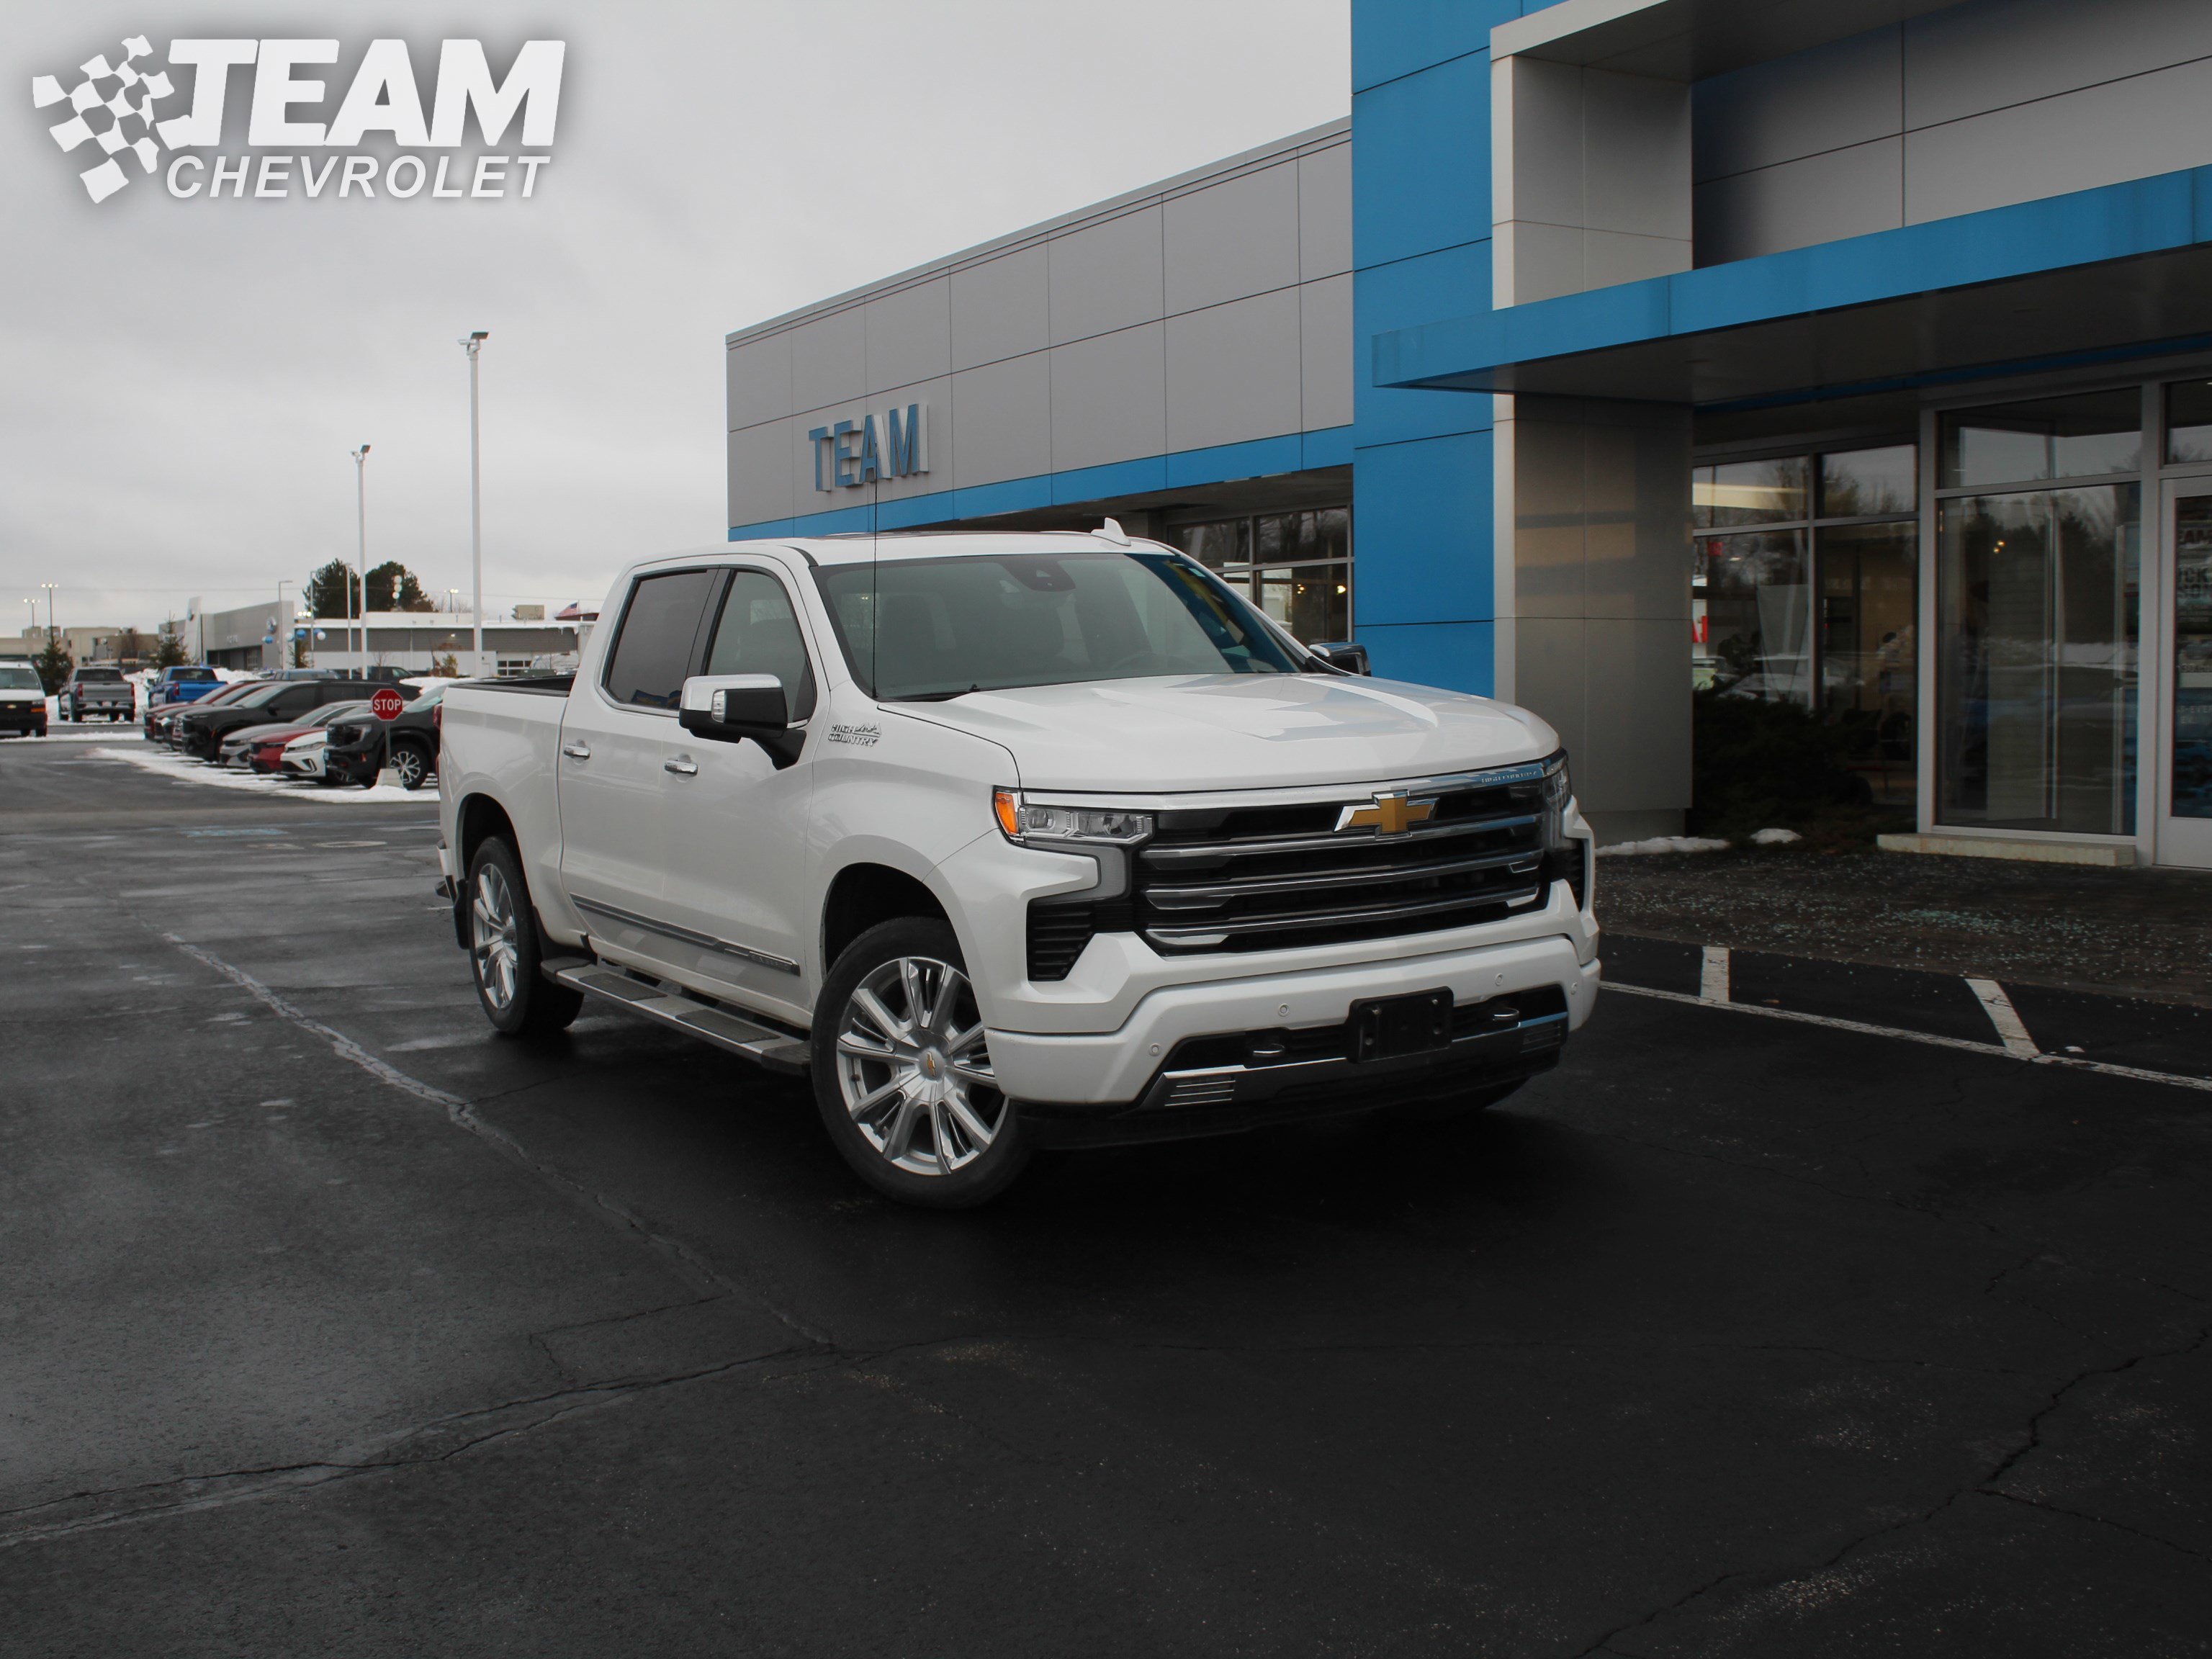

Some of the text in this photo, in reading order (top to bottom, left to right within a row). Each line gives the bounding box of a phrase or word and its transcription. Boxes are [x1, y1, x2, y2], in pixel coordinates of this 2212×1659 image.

[808, 403, 930, 493] TEAM
[374, 699, 401, 711] STOP
[828, 734, 878, 746] COUNTRY
